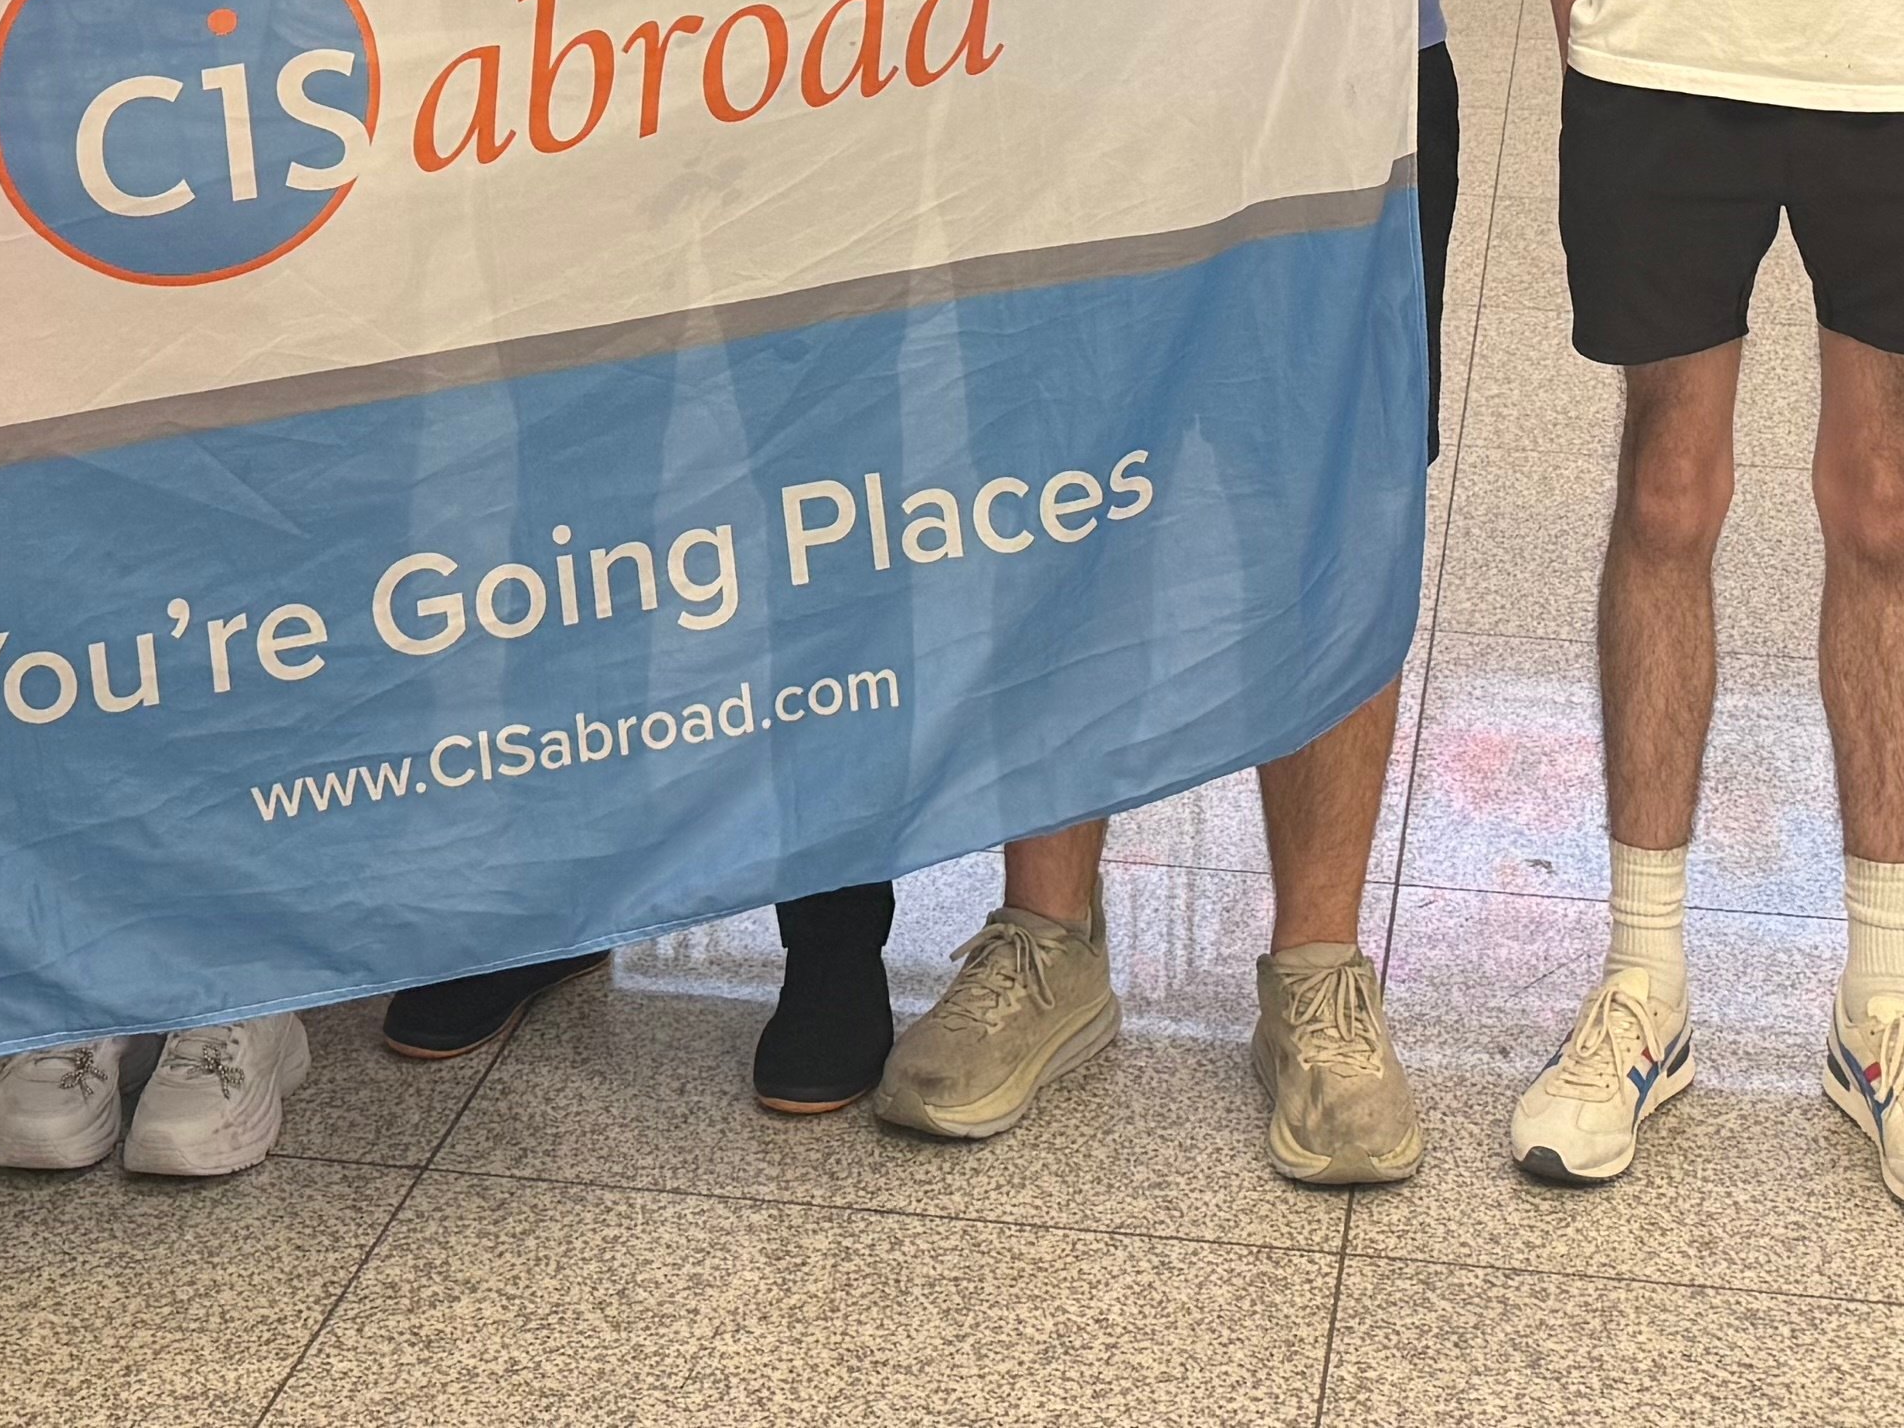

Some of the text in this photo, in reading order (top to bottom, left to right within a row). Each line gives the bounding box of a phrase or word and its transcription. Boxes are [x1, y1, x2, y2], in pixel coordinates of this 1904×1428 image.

[371, 523, 738, 655] Going
[780, 447, 1154, 587] Places
[250, 661, 901, 821] www.CISabroad.com
